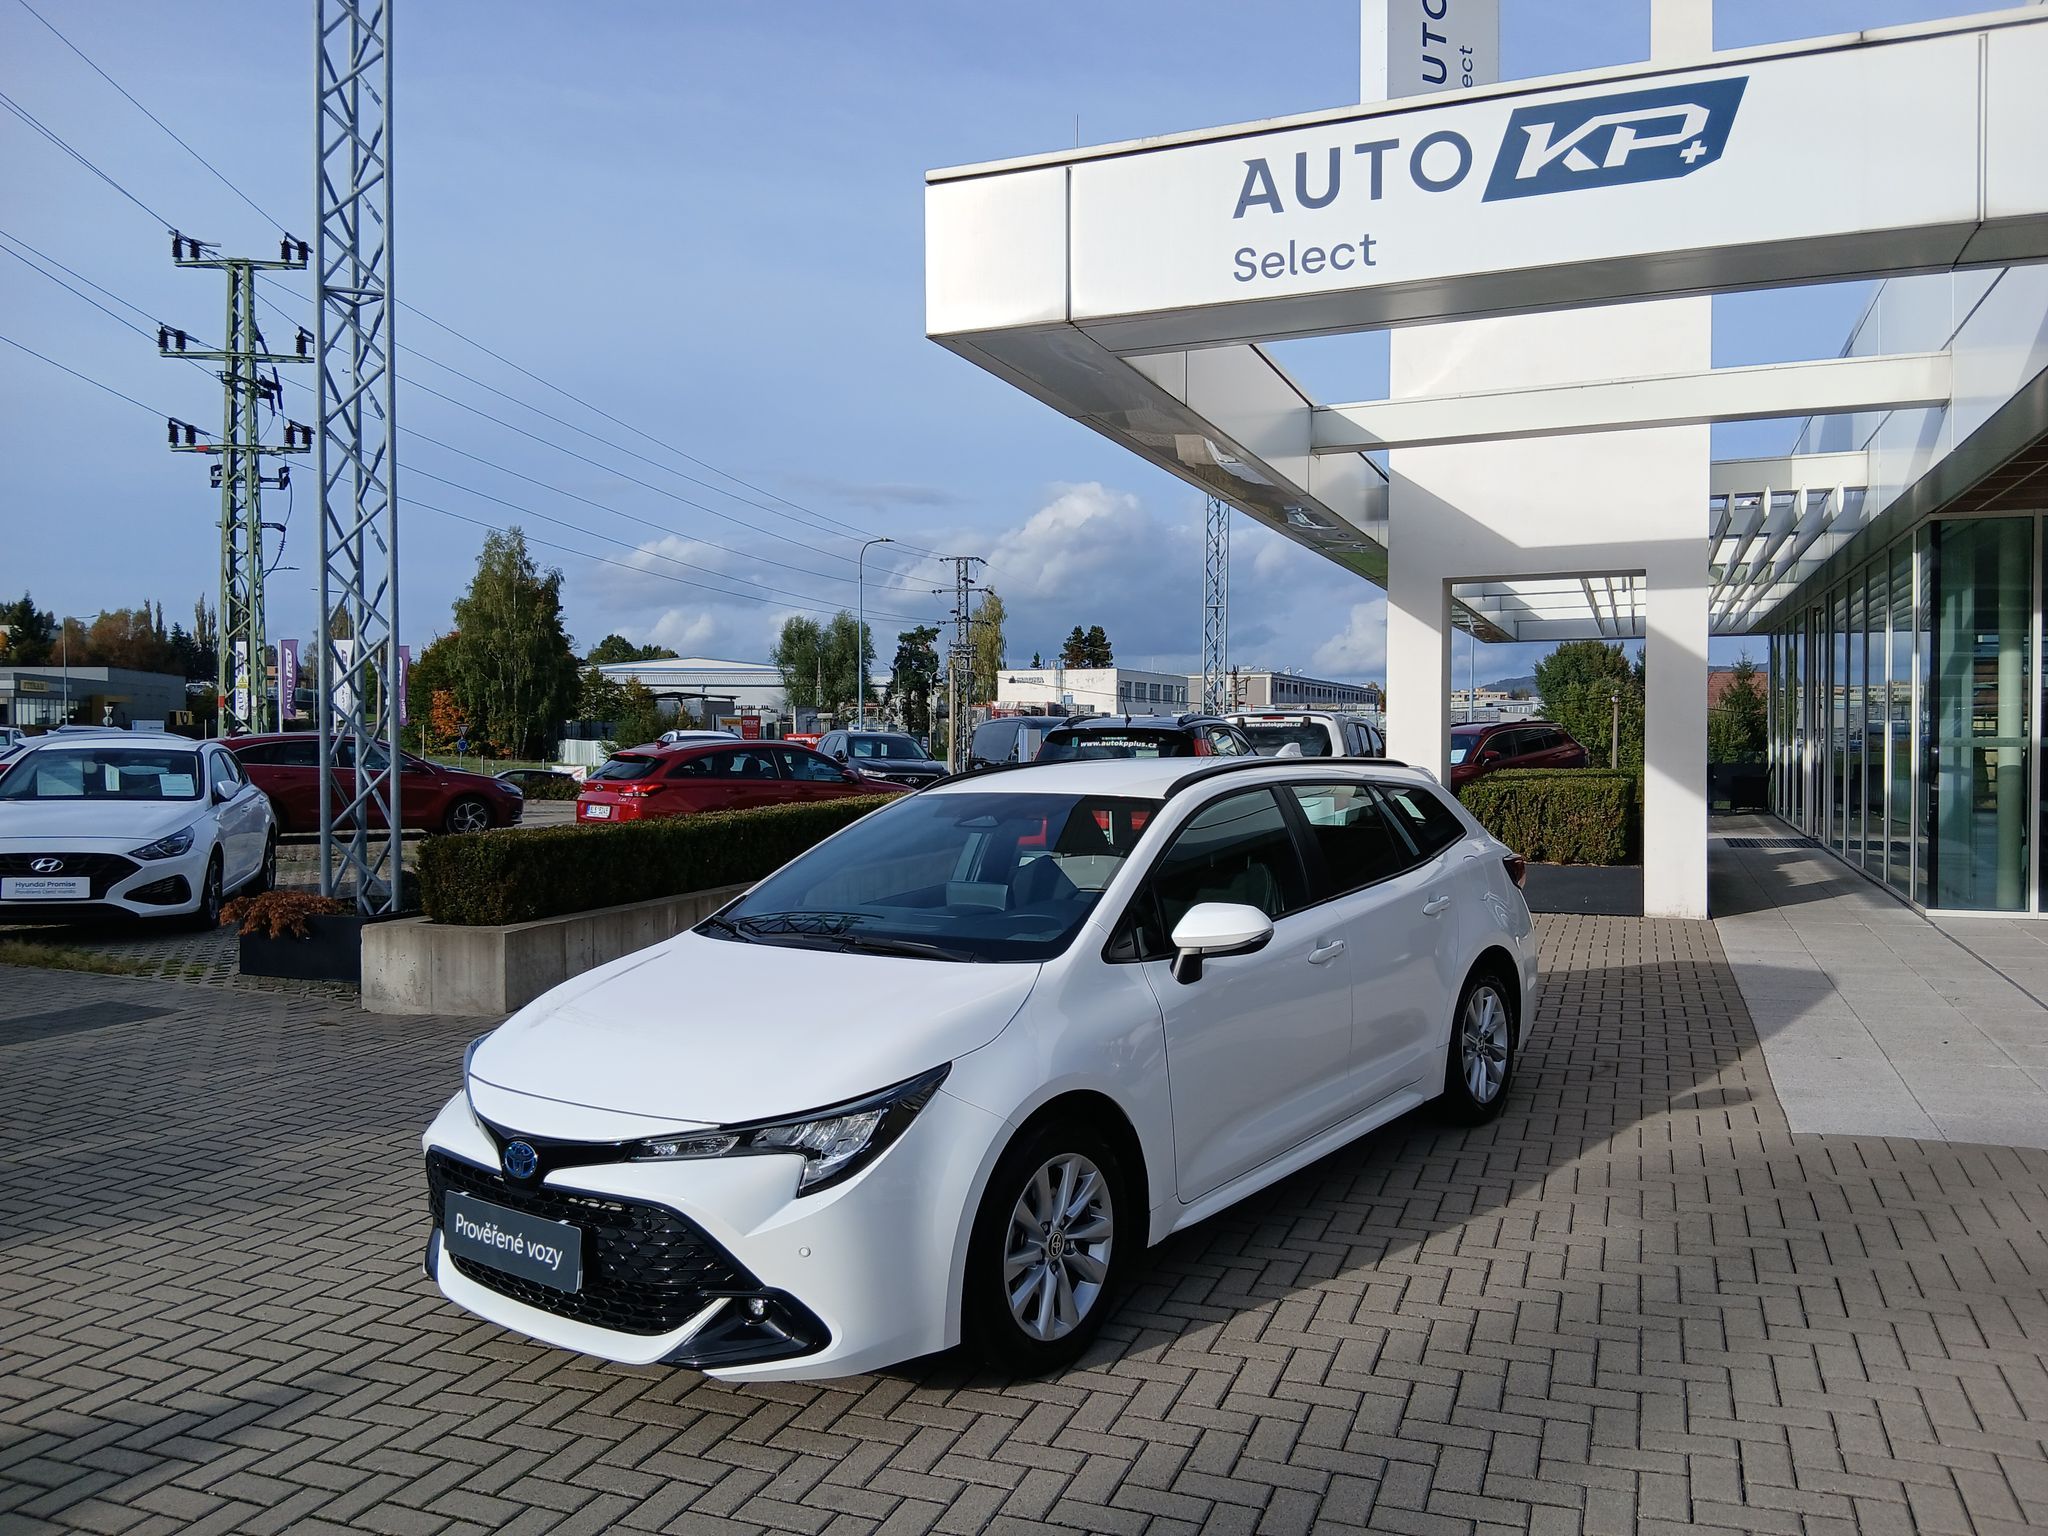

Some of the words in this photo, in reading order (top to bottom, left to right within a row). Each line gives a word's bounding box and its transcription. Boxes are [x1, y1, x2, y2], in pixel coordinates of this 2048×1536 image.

[1422, 0, 1447, 84] UTO
[1459, 45, 1473, 88] ect
[1232, 130, 1473, 219] AUTO
[1233, 233, 1377, 282] Select
[1080, 740, 1158, 749] www.autokpplus.cz
[15, 881, 46, 889] Hyundai
[455, 1213, 524, 1255] Prověřené
[527, 1240, 563, 1271] vozy
